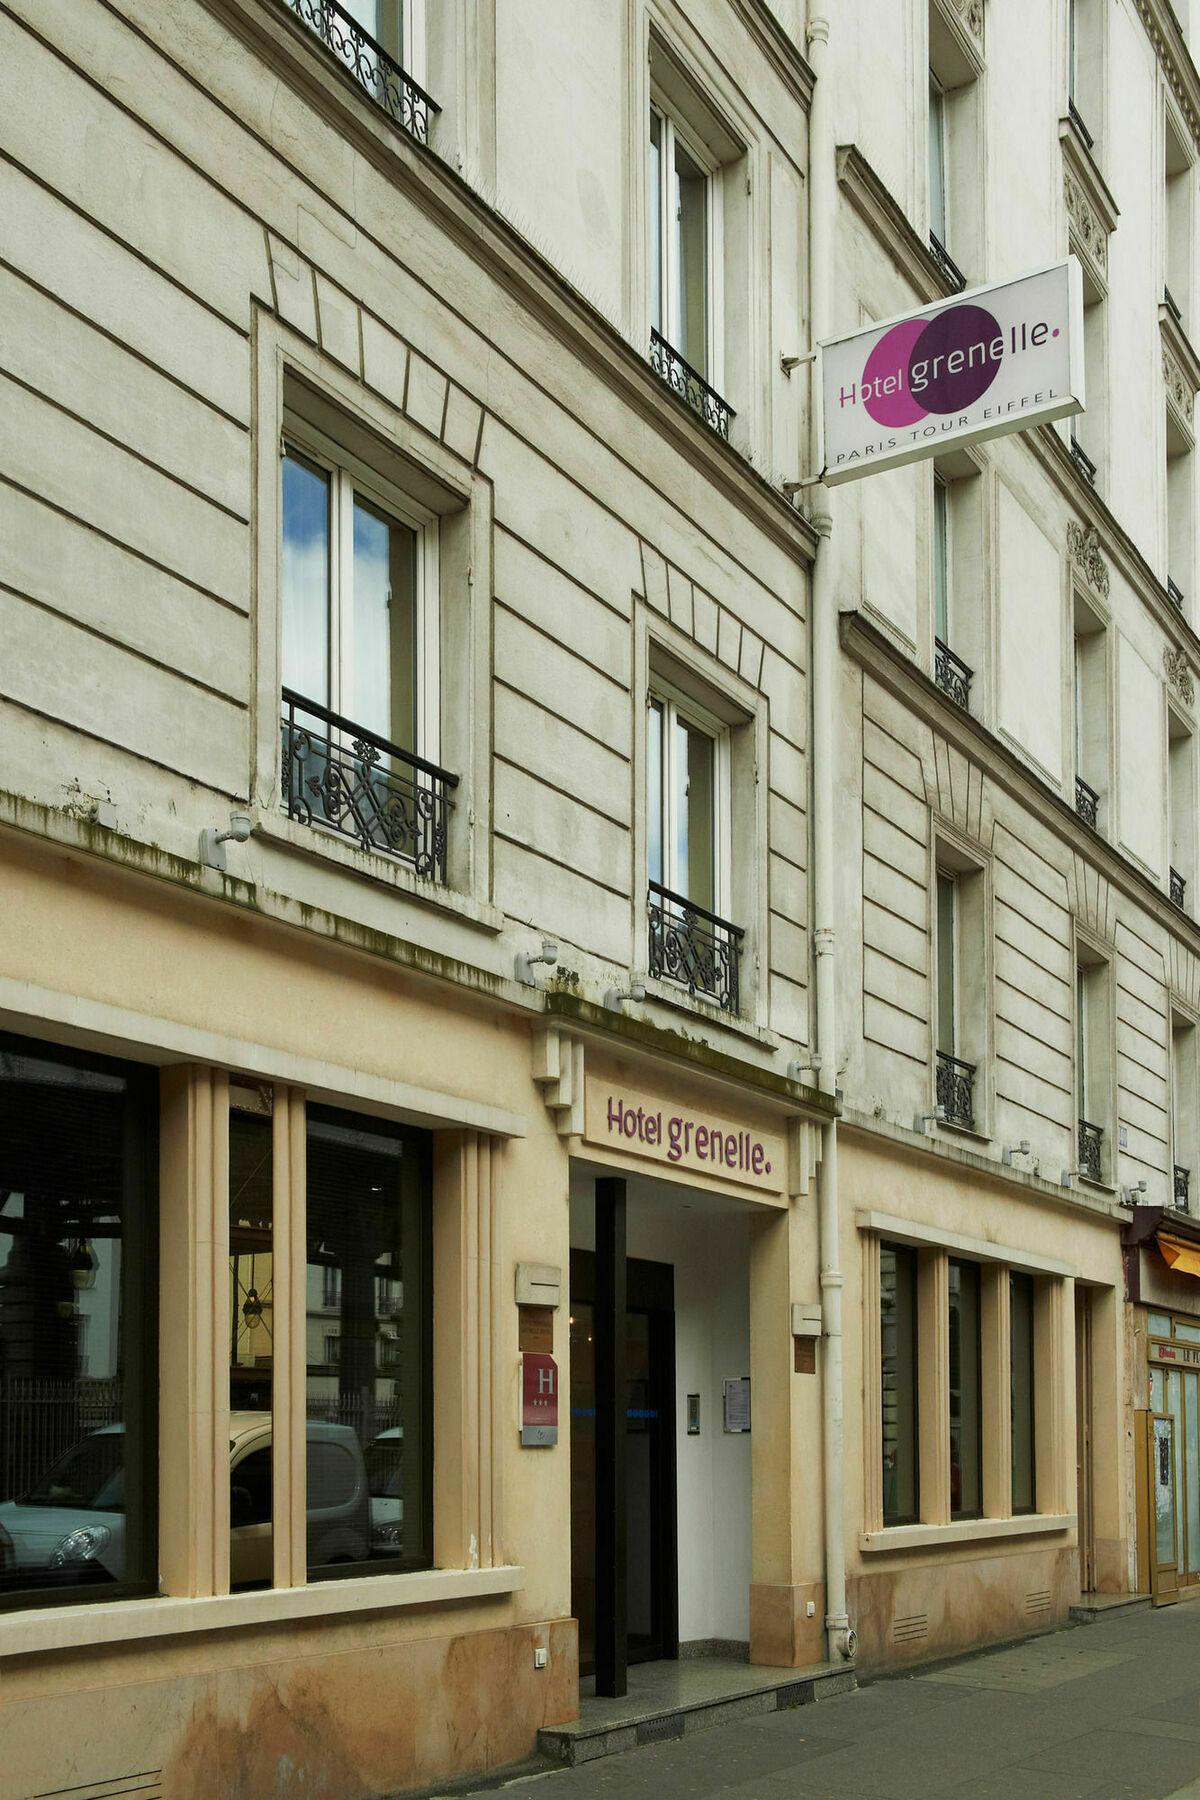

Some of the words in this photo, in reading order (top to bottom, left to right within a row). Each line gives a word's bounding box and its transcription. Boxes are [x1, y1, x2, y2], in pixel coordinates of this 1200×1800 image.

[839, 368, 903, 408] Hotel
[910, 322, 1060, 393] grenelle.
[836, 438, 897, 464] PARIS
[910, 415, 969, 441] TOUR
[983, 389, 1058, 419] EIFFEL
[607, 1096, 662, 1146] Hotel
[667, 1116, 772, 1175] grenelle.
[538, 1368, 554, 1395] H
